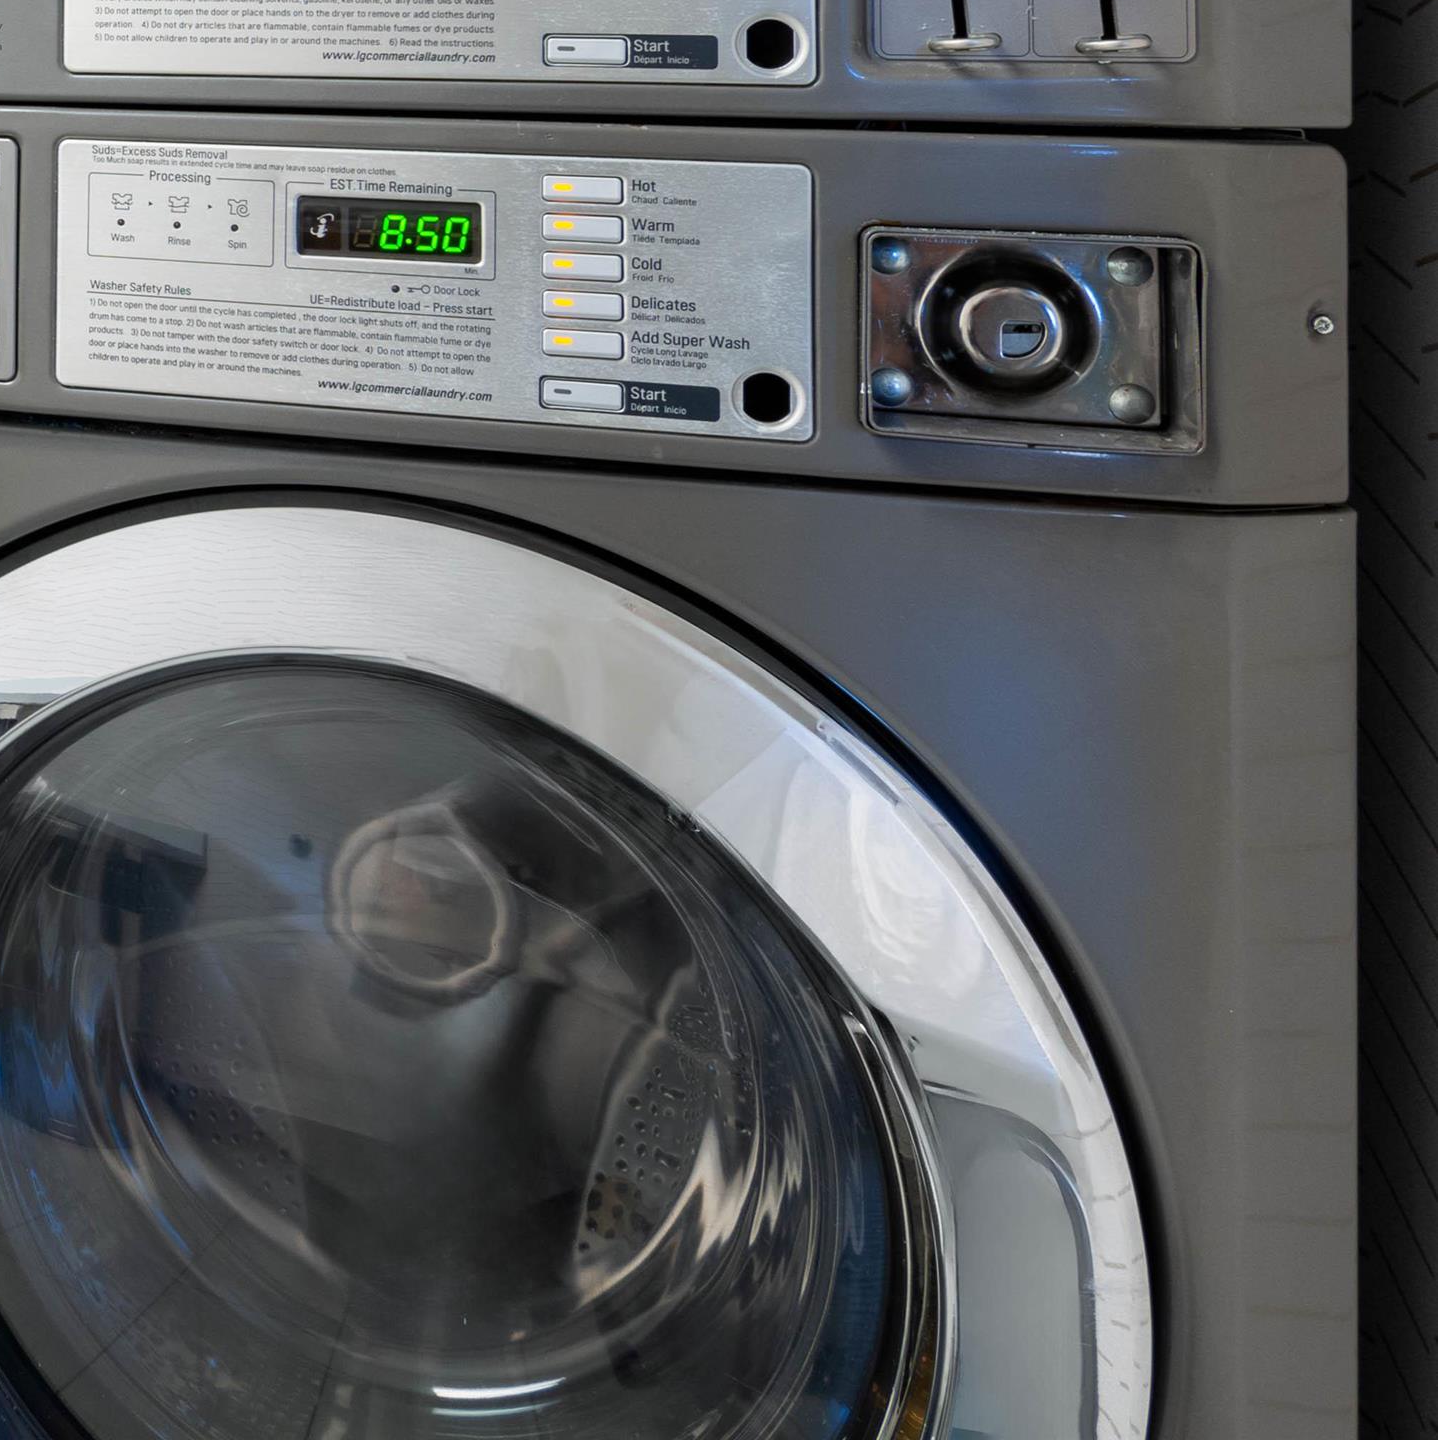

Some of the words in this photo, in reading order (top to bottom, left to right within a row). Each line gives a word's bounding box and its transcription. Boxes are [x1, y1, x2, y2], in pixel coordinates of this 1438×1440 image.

[633, 39, 670, 53] Start
[322, 51, 496, 64] www.lgcommerciallaundry.com
[159, 148, 183, 158] Suds
[185, 148, 228, 160] Removal
[149, 170, 212, 185] Processing
[389, 181, 453, 197] Remaining
[631, 179, 656, 192] Hot
[631, 195, 658, 204] Chaud
[662, 196, 697, 206] Caliente
[631, 218, 675, 232] Warm
[110, 232, 135, 243] Wash
[379, 214, 470, 253] 8.50
[167, 236, 191, 246] Rinse
[227, 240, 247, 250] Spin
[631, 257, 662, 271] Cold
[90, 279, 127, 291] Washer
[130, 282, 163, 295] Safety
[164, 284, 192, 296] Rules
[433, 285, 456, 296] Door
[457, 286, 481, 297] Lock
[310, 294, 395, 310] UE=Redistribute
[398, 299, 421, 311] load
[433, 302, 464, 314] Press
[466, 305, 493, 316] start
[631, 296, 697, 312] Delicates
[631, 331, 659, 344] Add
[663, 333, 705, 349] Super
[709, 335, 750, 350] Wash
[631, 346, 654, 356] Cycle
[655, 347, 677, 358] Long
[678, 349, 709, 360] Lavage
[631, 356, 651, 365] Ciclo
[682, 359, 707, 370] Largo
[318, 380, 493, 402] www.lgcommerciallaundry.com
[630, 387, 667, 402] Start
